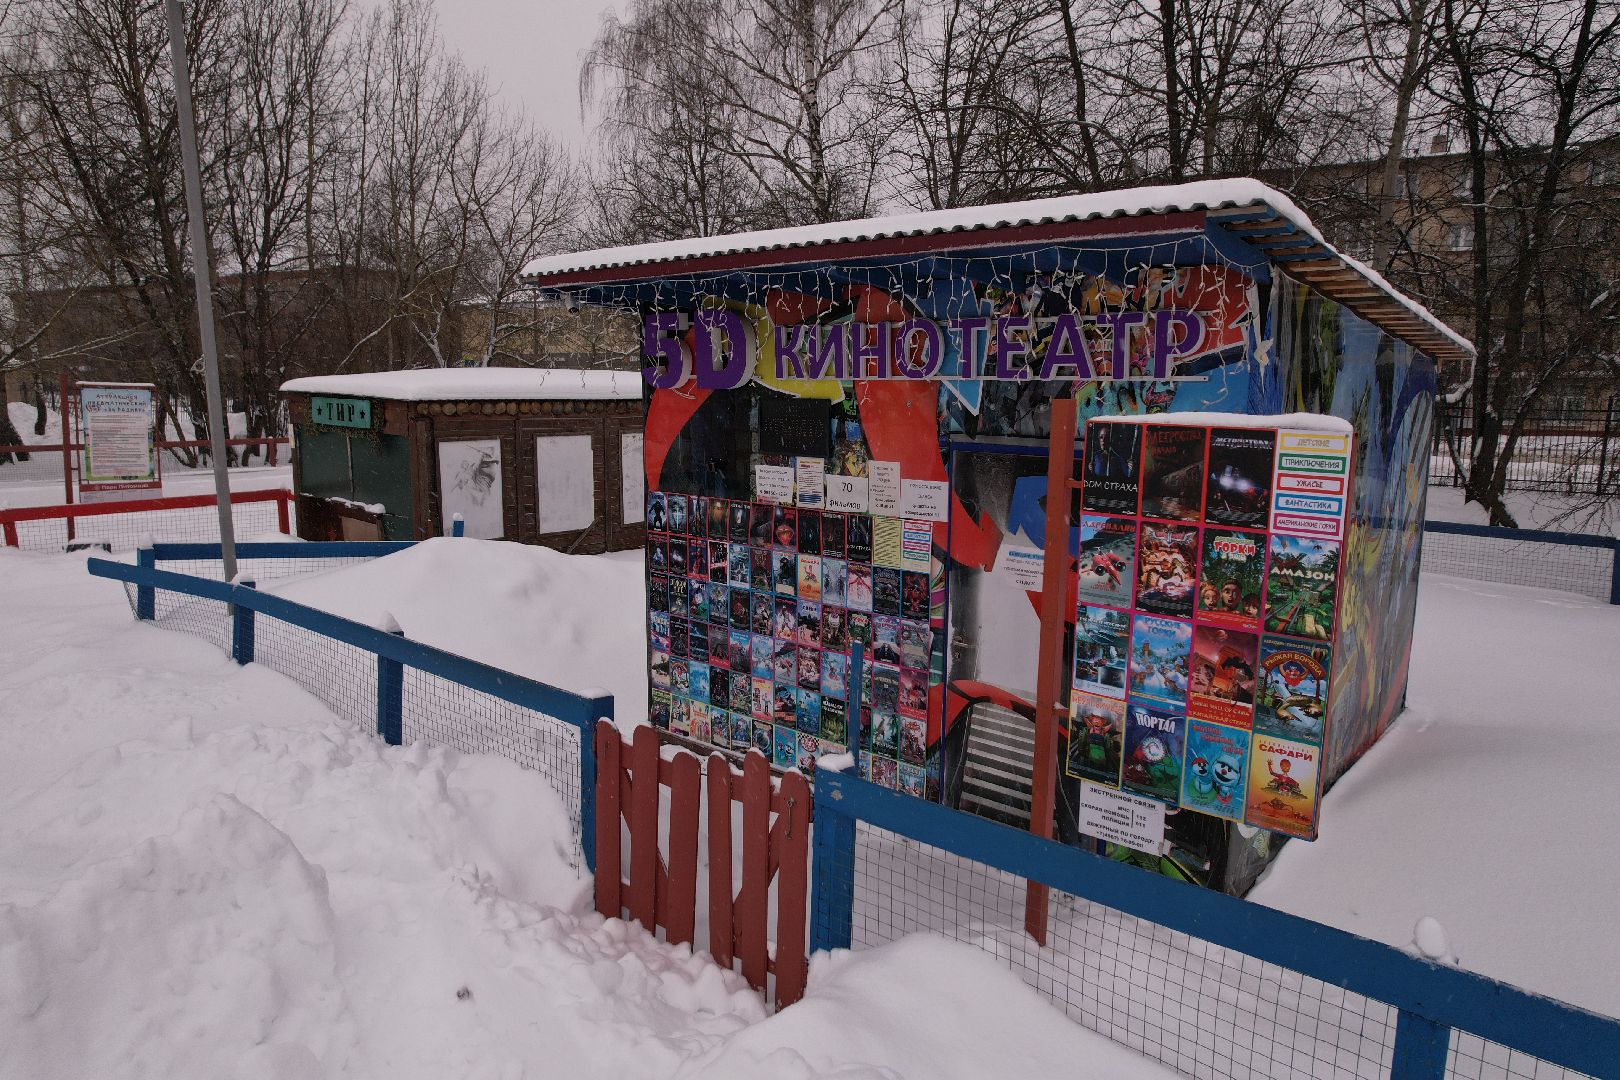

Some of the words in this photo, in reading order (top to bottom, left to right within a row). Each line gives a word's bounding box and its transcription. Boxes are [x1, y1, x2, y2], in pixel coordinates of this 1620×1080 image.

[641, 310, 756, 390] 5D
[773, 311, 1208, 380] КИНОТЕАТР
[326, 402, 355, 422] ТИР
[1296, 438, 1330, 447] ДЕТСКИЕ
[1284, 457, 1340, 469] ПРИКЛЮЧЕНИЯ
[841, 482, 853, 493] 70
[1083, 480, 1102, 489] ДОМ
[1103, 482, 1138, 492] СТРАХА
[1296, 479, 1324, 489] УЖАСЫ
[1284, 499, 1332, 510] ФАНТАСТИКА
[1214, 541, 1256, 557] ГОРКИ
[1270, 566, 1335, 582] АМАЗОН
[1294, 653, 1323, 676] БОРОДА
[1134, 712, 1176, 734] ПОРТАЛ
[1258, 743, 1313, 762] САФАРИ
[1089, 786, 1132, 804] ЭКСТРЕННОЙ
[1133, 799, 1156, 810] СВЯЗИ
[1081, 802, 1103, 812] СКОРАЯ
[1103, 808, 1130, 820] ПОМОЩЬ
[1086, 820, 1119, 834] ДЕЖУРНЫЙ
[1120, 829, 1129, 837] ПО
